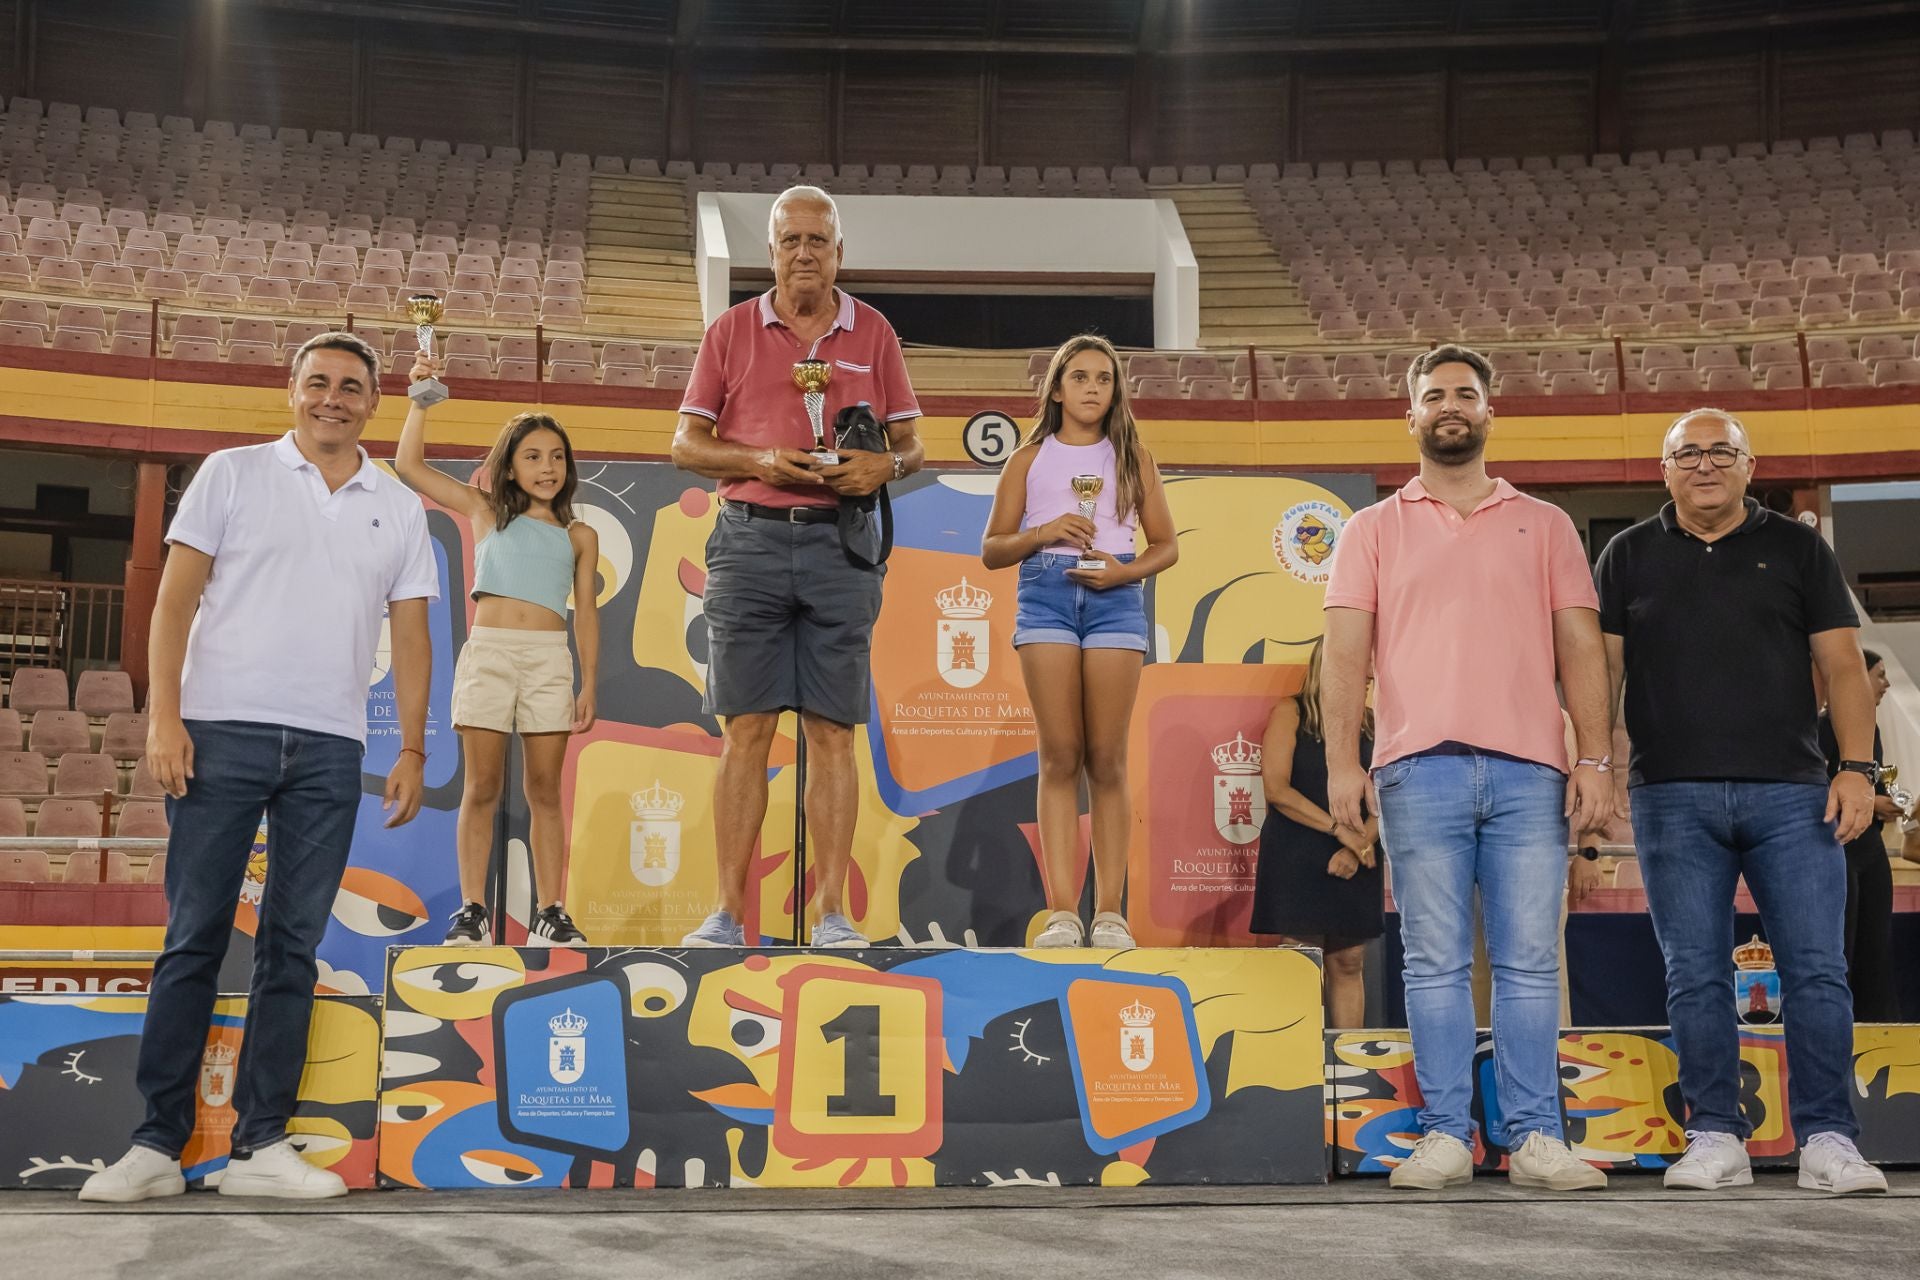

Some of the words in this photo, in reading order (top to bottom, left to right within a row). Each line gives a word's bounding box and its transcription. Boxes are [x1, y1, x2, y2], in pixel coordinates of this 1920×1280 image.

[981, 422, 1004, 457] 5
[1312, 573, 1329, 582] VID
[918, 692, 994, 701] AYUNTAMIENTO
[997, 693, 1009, 701] DE
[374, 705, 392, 717] DE
[895, 703, 968, 719] ROQUETAS
[974, 706, 991, 717] DE
[998, 704, 1032, 718] MAR
[909, 727, 919, 735] de
[956, 728, 982, 736] Cultura
[983, 729, 988, 737] y
[989, 728, 1016, 737] Tiempo
[1196, 848, 1258, 857] AYUNTAMIEN
[1173, 859, 1246, 876] ROQUETAS
[1188, 883, 1198, 892] de
[1234, 884, 1256, 892] Cultur
[588, 901, 658, 916] ROQUETAS
[664, 904, 681, 915] DE
[820, 1005, 896, 1117] 1
[1095, 1081, 1141, 1092] ROQUETAS
[1144, 1083, 1155, 1091] DE
[1159, 1081, 1181, 1091] MAR
[520, 1094, 570, 1105] ROQUETAS
[573, 1095, 585, 1104] DE
[589, 1094, 612, 1104] MAR
